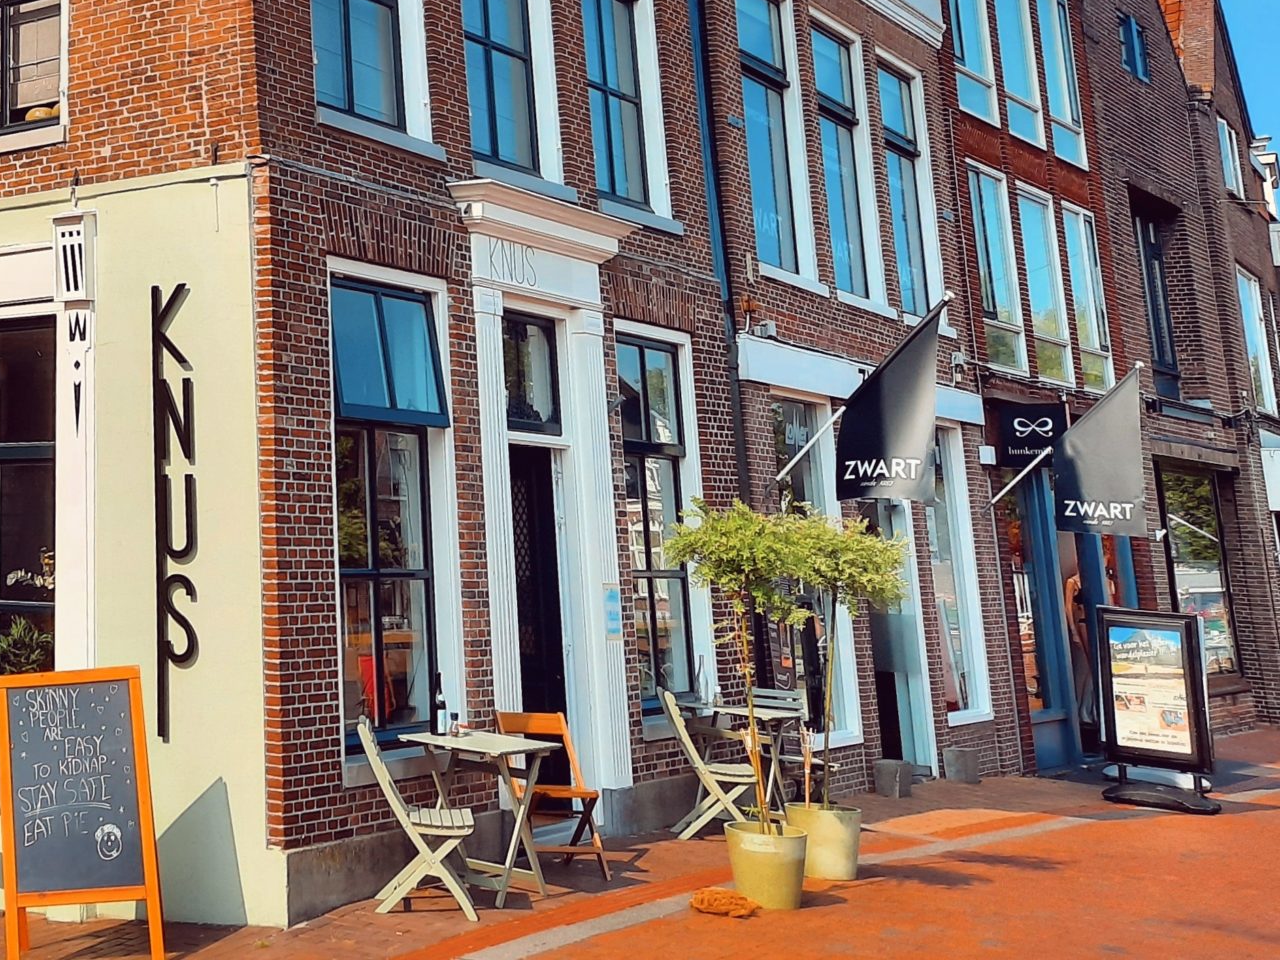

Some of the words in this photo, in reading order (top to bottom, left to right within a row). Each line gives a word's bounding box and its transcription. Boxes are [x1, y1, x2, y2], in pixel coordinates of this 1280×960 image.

[487, 237, 537, 287] KNUS
[843, 458, 922, 480] ZWART
[151, 282, 198, 742] KNUS
[1063, 500, 1134, 520] ZWART
[29, 708, 80, 729] PEOPLE
[44, 727, 64, 741] ARE
[64, 735, 104, 758] EASY
[32, 762, 51, 780] TO
[17, 780, 58, 813] STAY
[63, 775, 112, 805] SAFE
[23, 815, 55, 847] EAT
